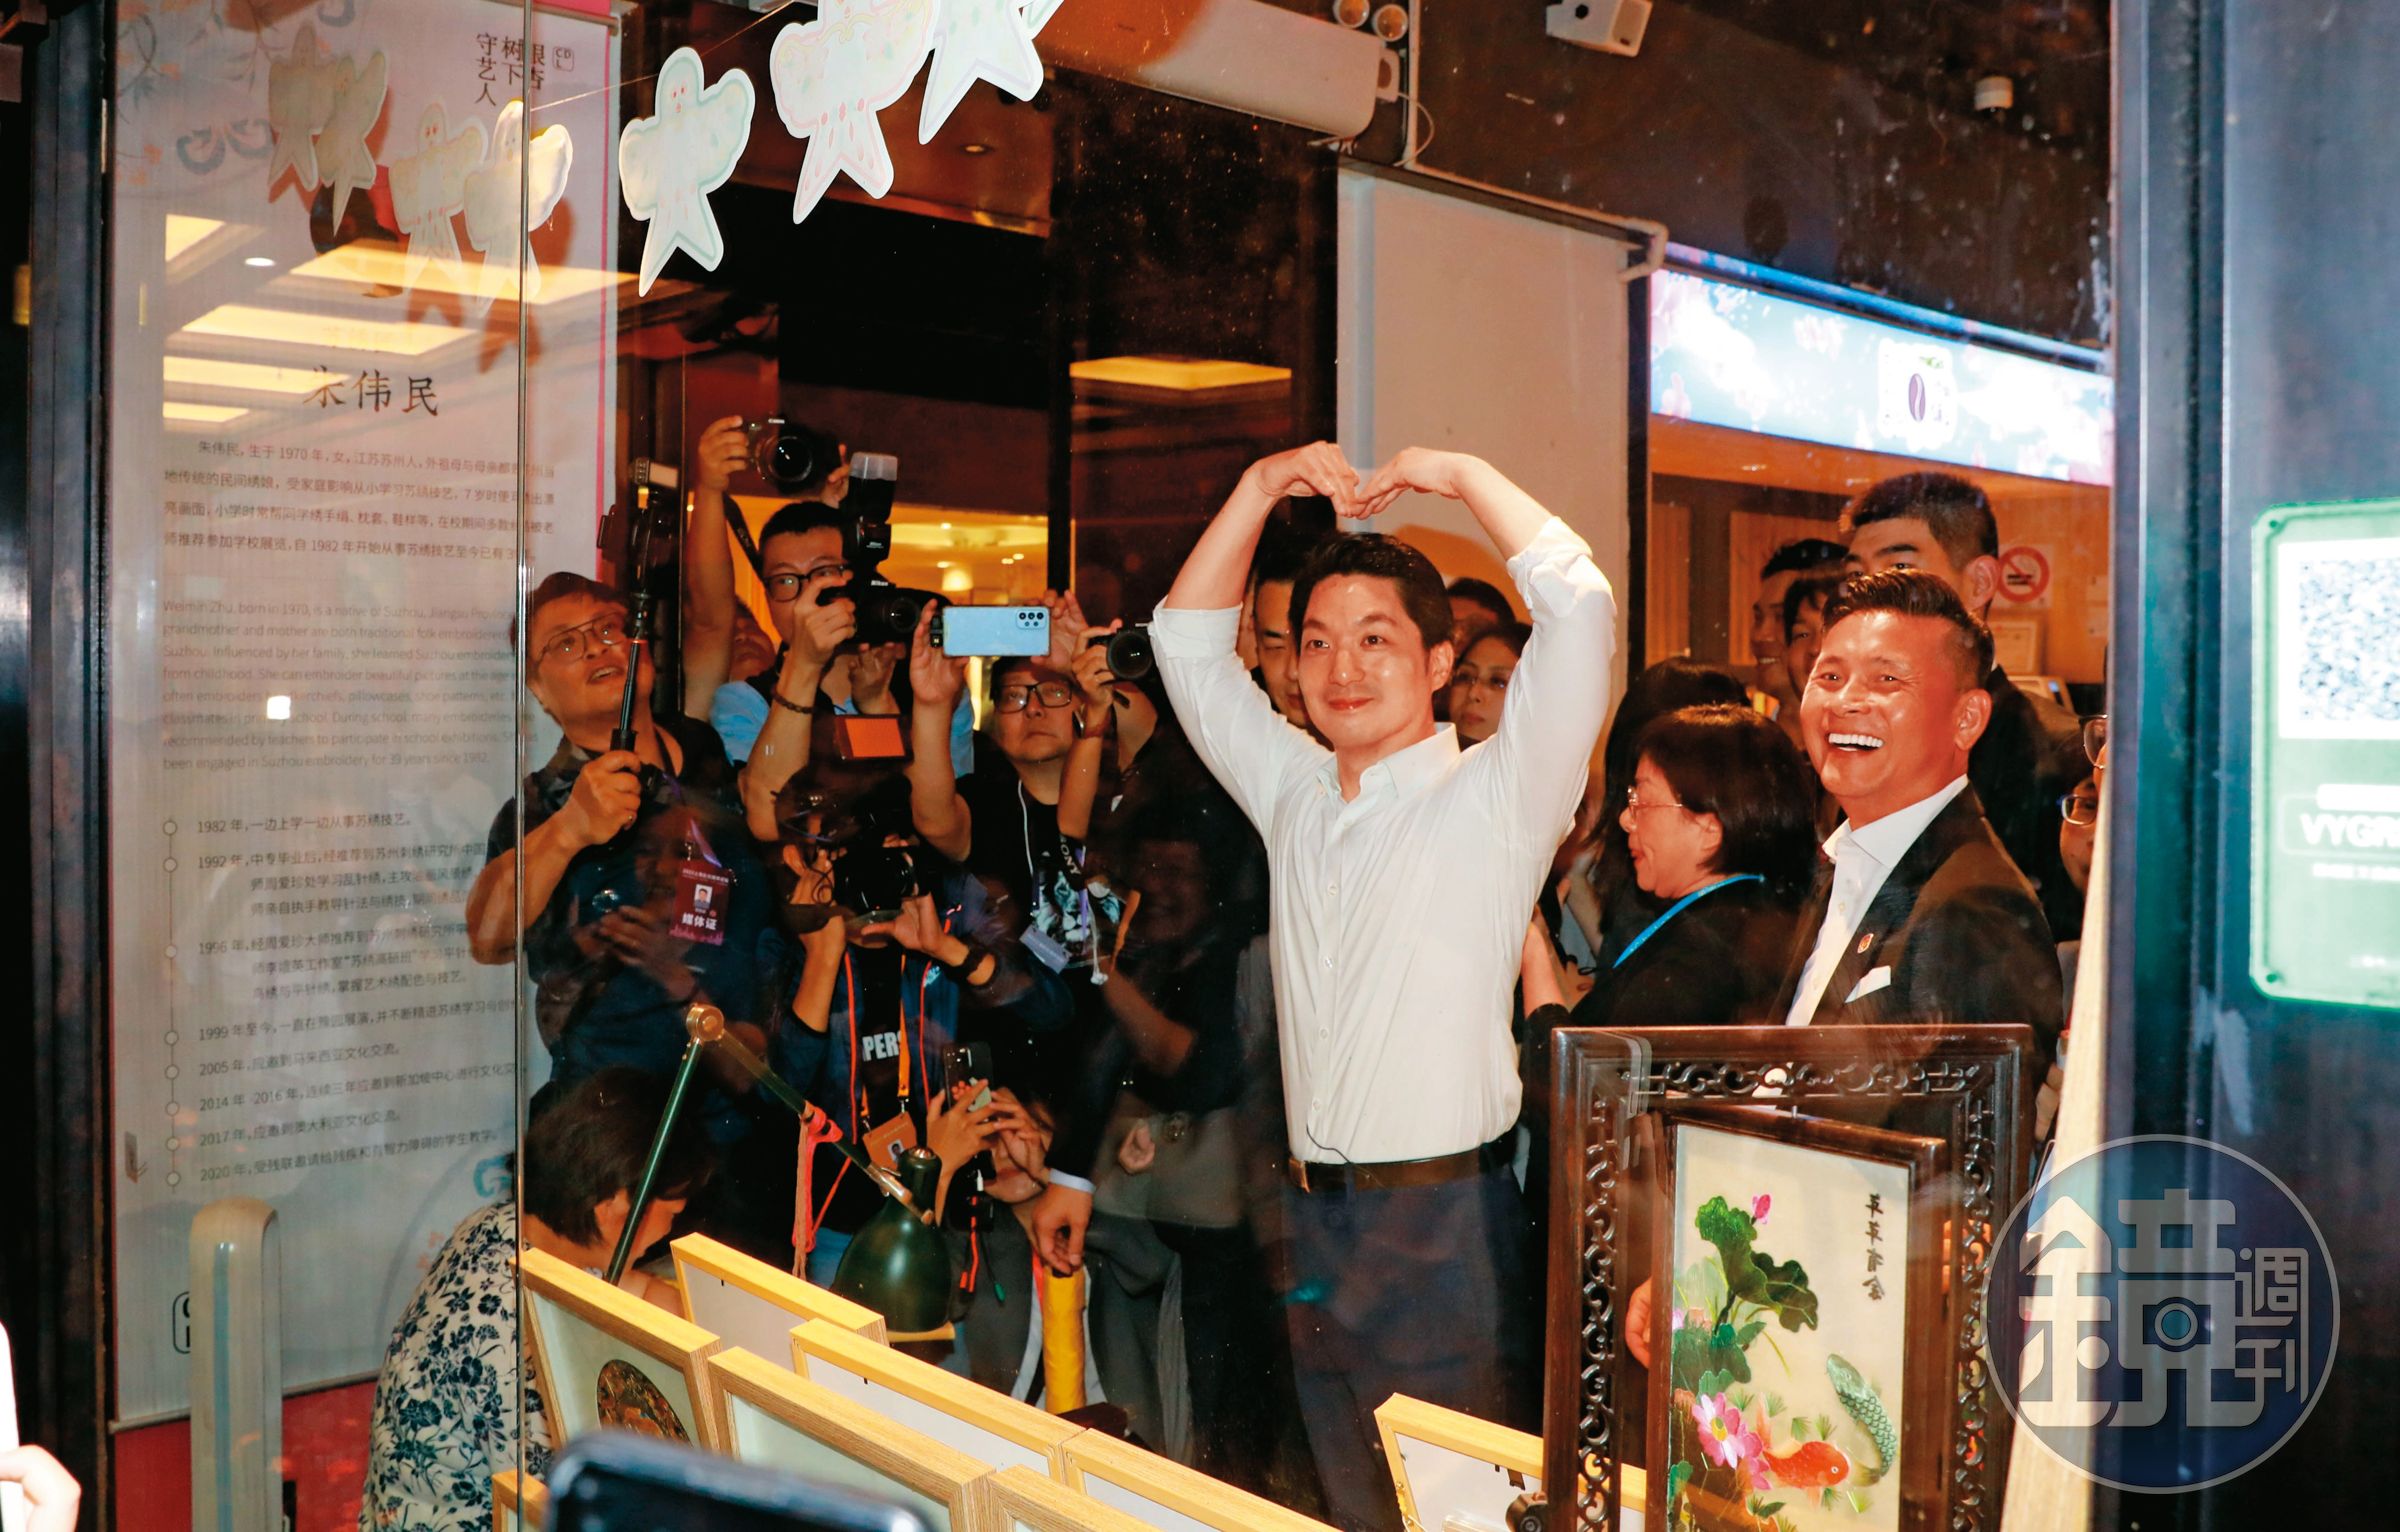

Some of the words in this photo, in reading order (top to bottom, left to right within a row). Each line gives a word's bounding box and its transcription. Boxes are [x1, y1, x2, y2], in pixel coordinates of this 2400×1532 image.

[475, 32, 498, 107] 守艺人
[682, 912, 718, 930] 媒体证
[862, 1030, 902, 1062] PER
